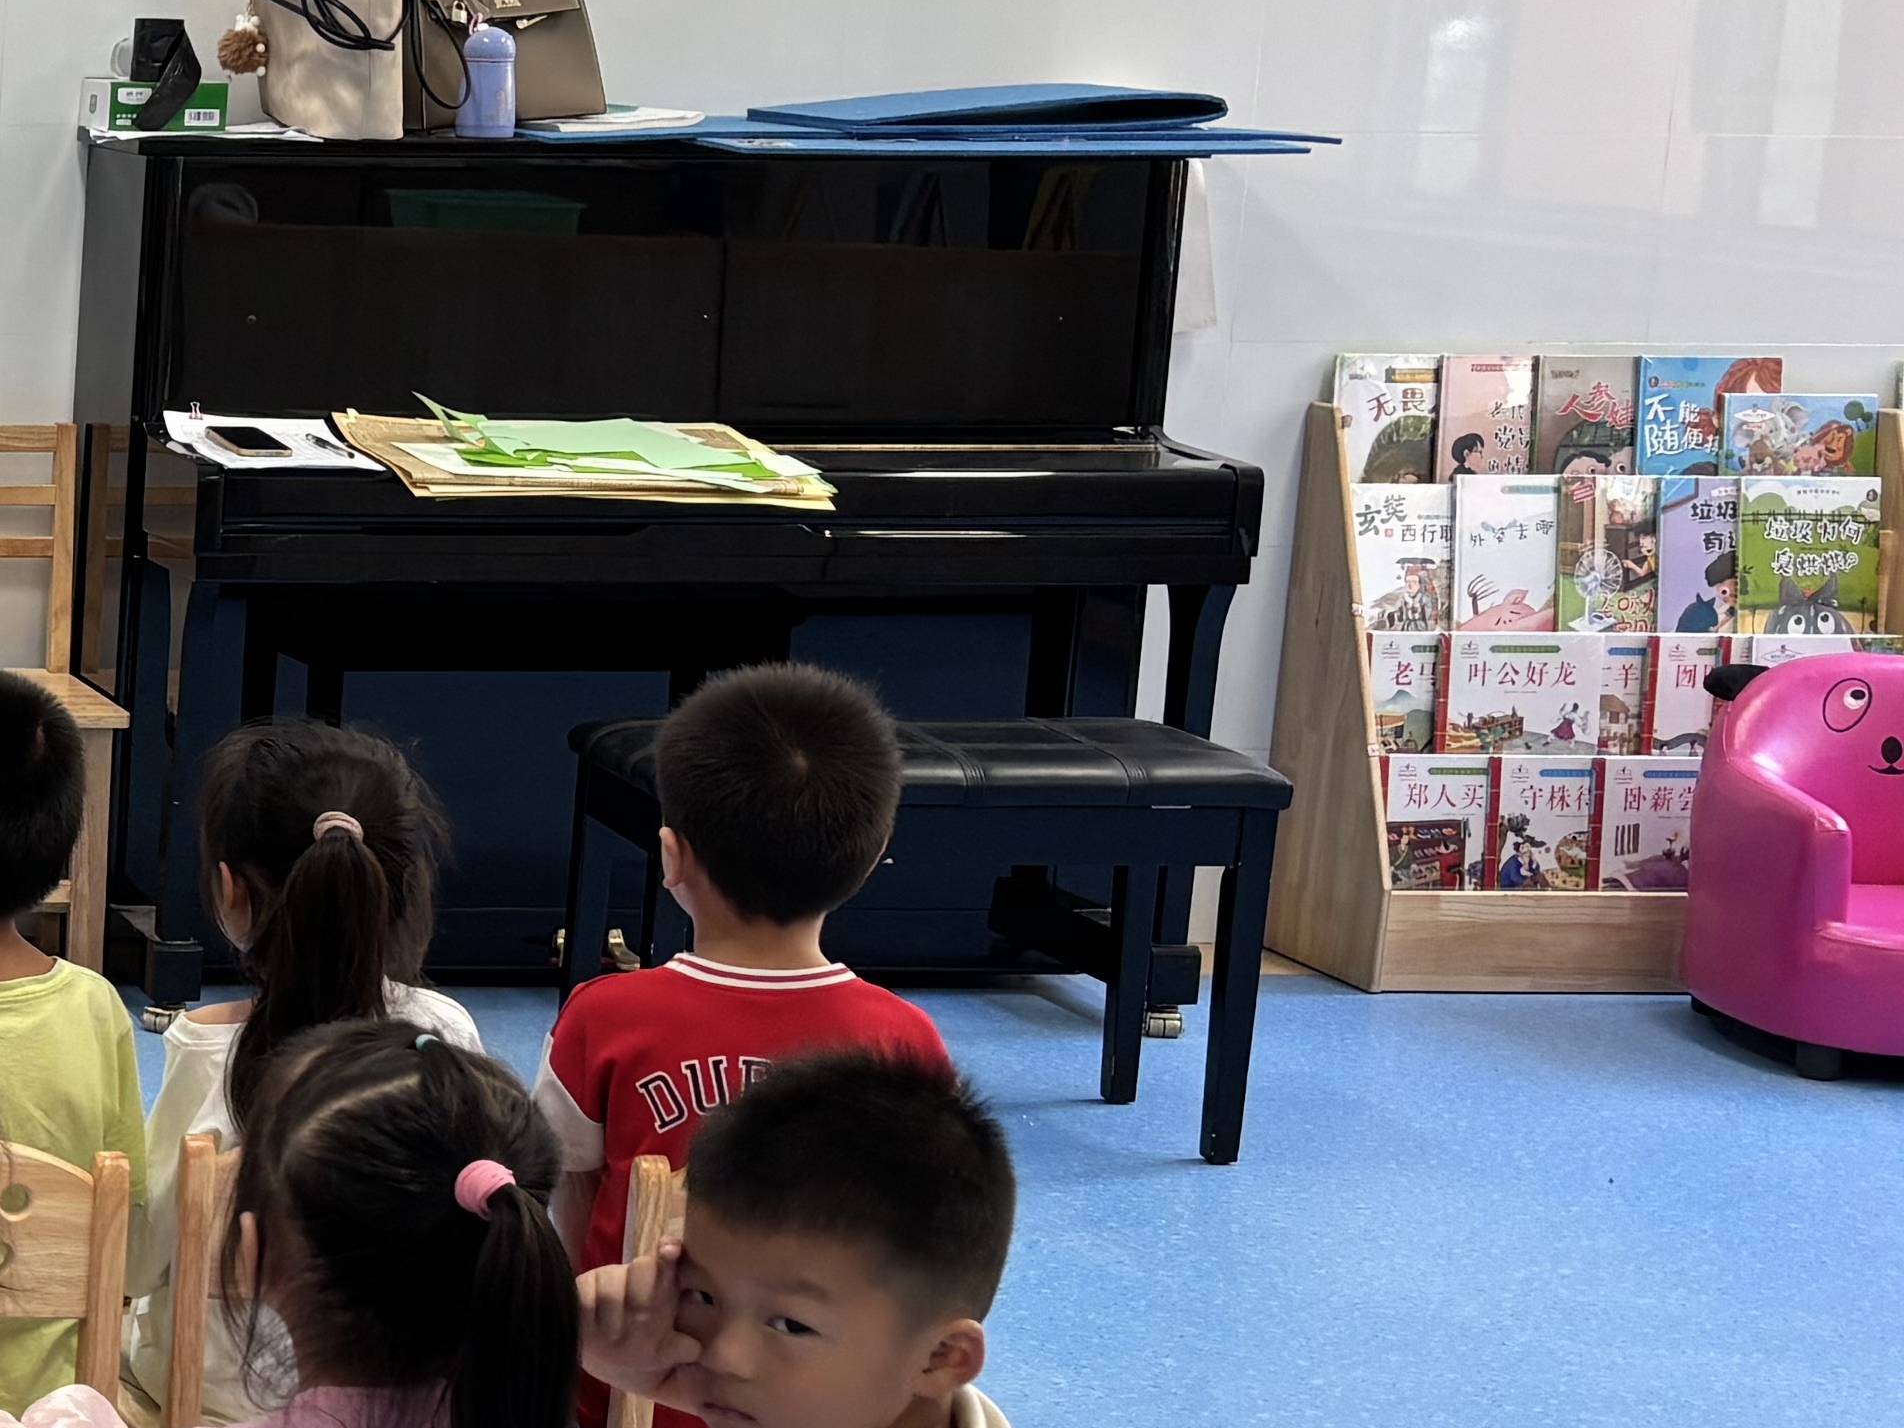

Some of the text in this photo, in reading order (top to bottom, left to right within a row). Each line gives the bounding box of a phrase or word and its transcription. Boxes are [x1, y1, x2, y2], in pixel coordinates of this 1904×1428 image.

[1467, 659, 1578, 688] 叶公好龙
[1403, 782, 1485, 811] 郑人买
